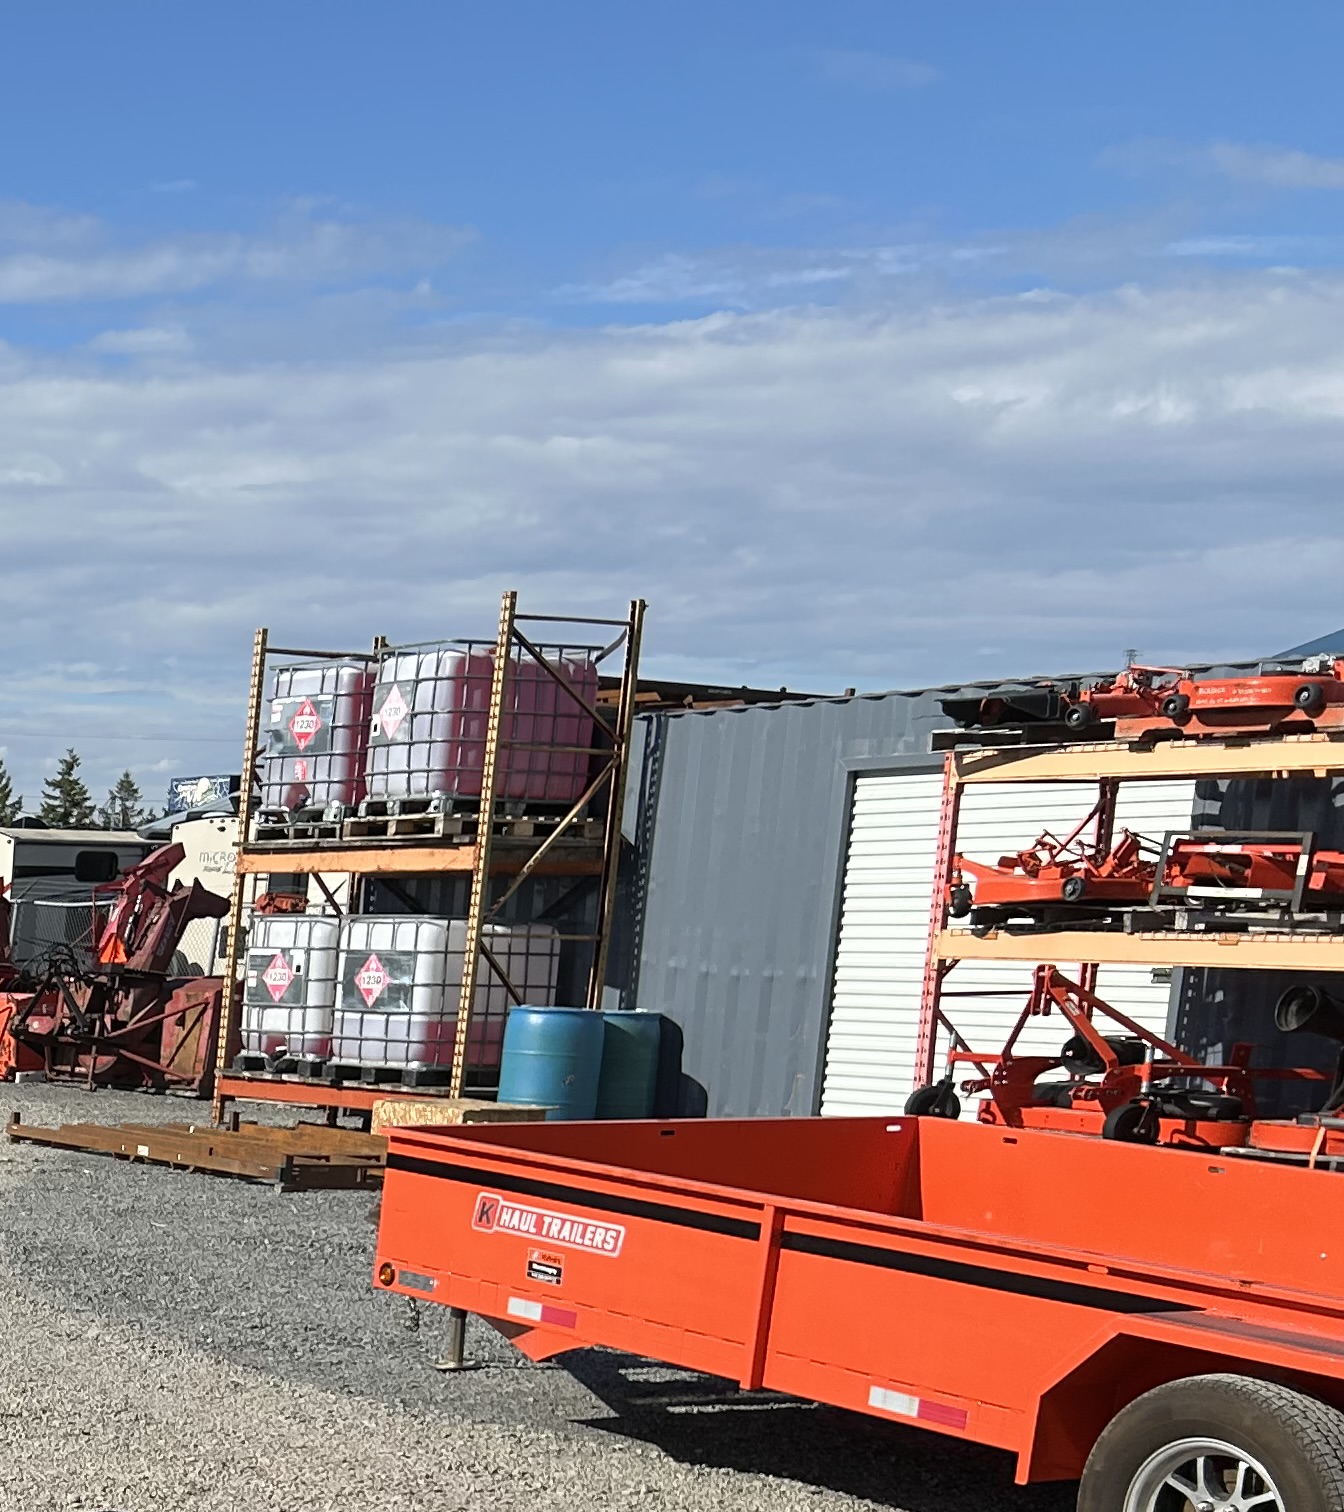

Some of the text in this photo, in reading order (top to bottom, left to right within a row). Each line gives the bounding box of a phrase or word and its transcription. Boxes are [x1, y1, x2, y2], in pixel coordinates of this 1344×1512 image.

[384, 706, 401, 717] 1230
[296, 718, 315, 729] 1230
[269, 972, 287, 982] 1230
[362, 975, 381, 985] 1230
[478, 1200, 617, 1251] K HAUL TRAILERS
